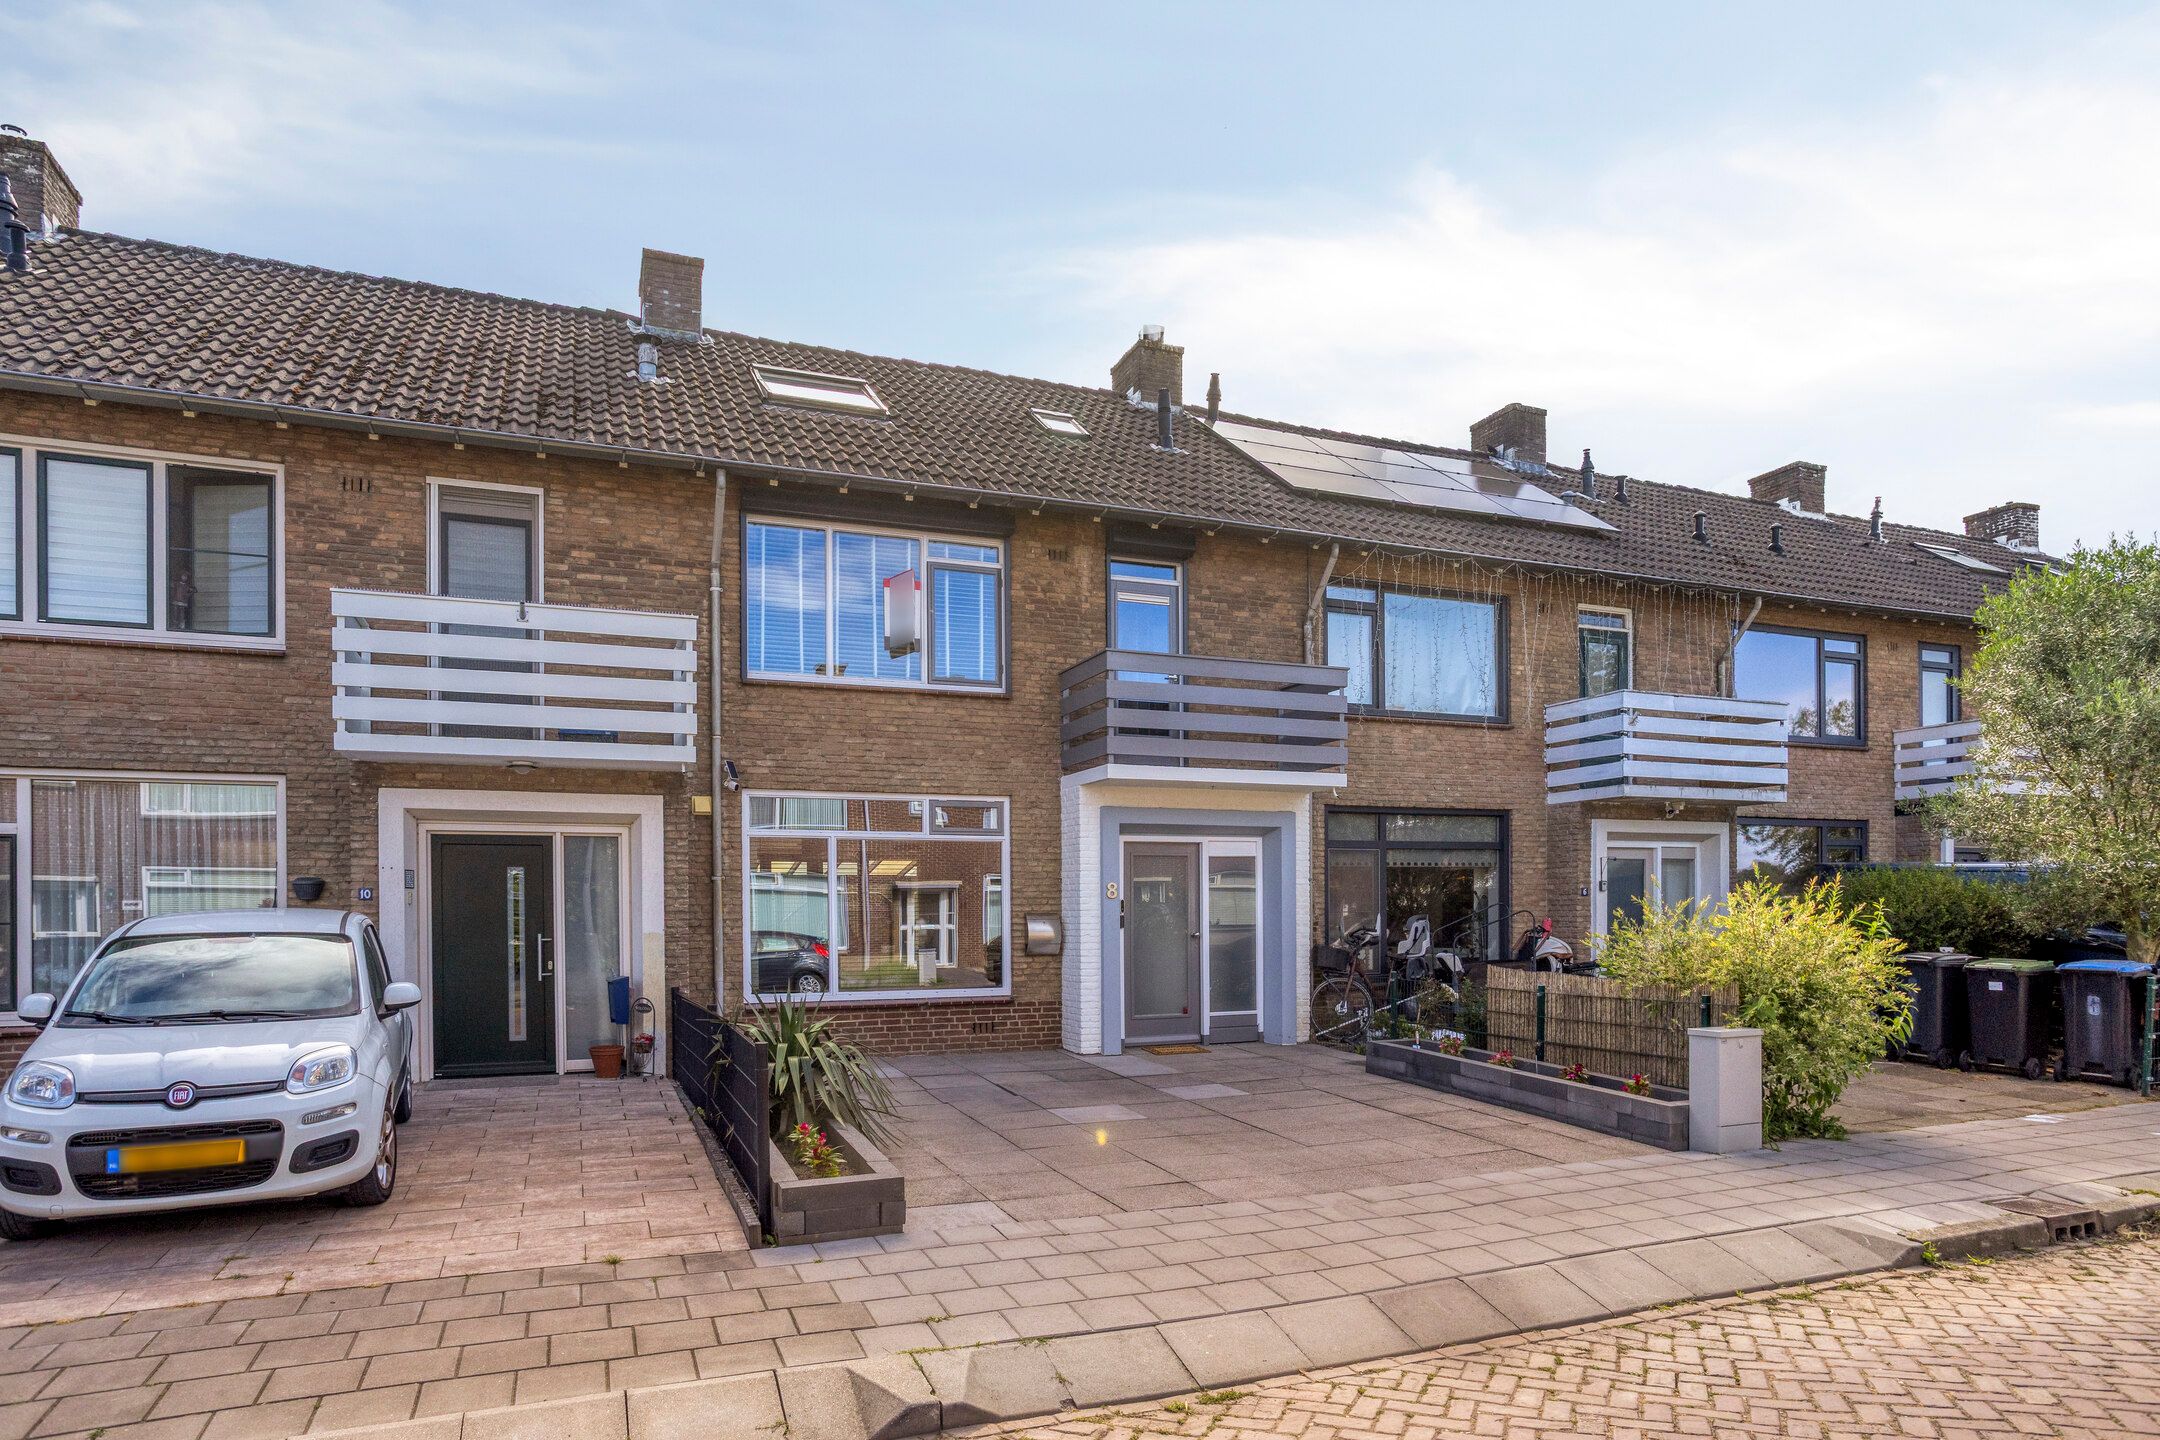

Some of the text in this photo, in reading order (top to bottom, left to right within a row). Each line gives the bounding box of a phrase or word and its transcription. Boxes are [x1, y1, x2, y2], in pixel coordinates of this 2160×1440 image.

[360, 889, 371, 899] 10
[1107, 882, 1118, 899] 8
[174, 1090, 188, 1100] FIAT
